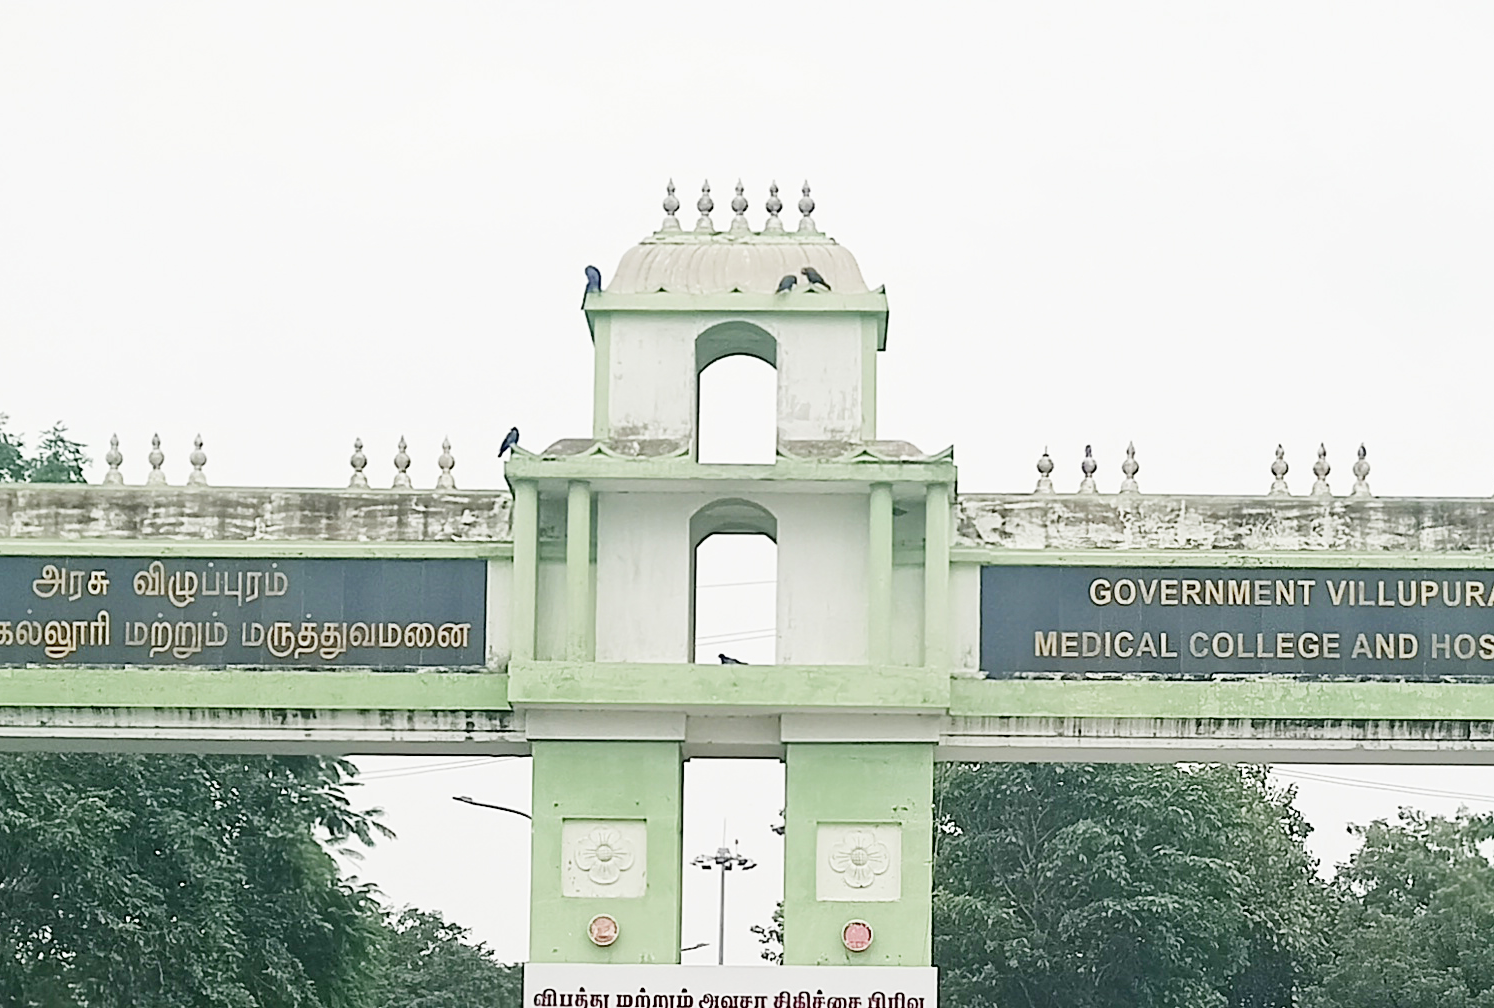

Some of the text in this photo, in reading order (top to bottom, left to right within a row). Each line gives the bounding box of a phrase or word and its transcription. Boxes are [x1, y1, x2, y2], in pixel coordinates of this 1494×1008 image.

[32, 560, 289, 608] அரசு விழுப்புரம்
[1088, 578, 1315, 608] GOVERNMENT
[124, 611, 229, 658] மற்றும்
[241, 612, 472, 659] மருத்துவமனை
[1033, 630, 1177, 660] MEDICAL
[1188, 631, 1341, 661] COLLEGE
[1351, 632, 1419, 661] AND
